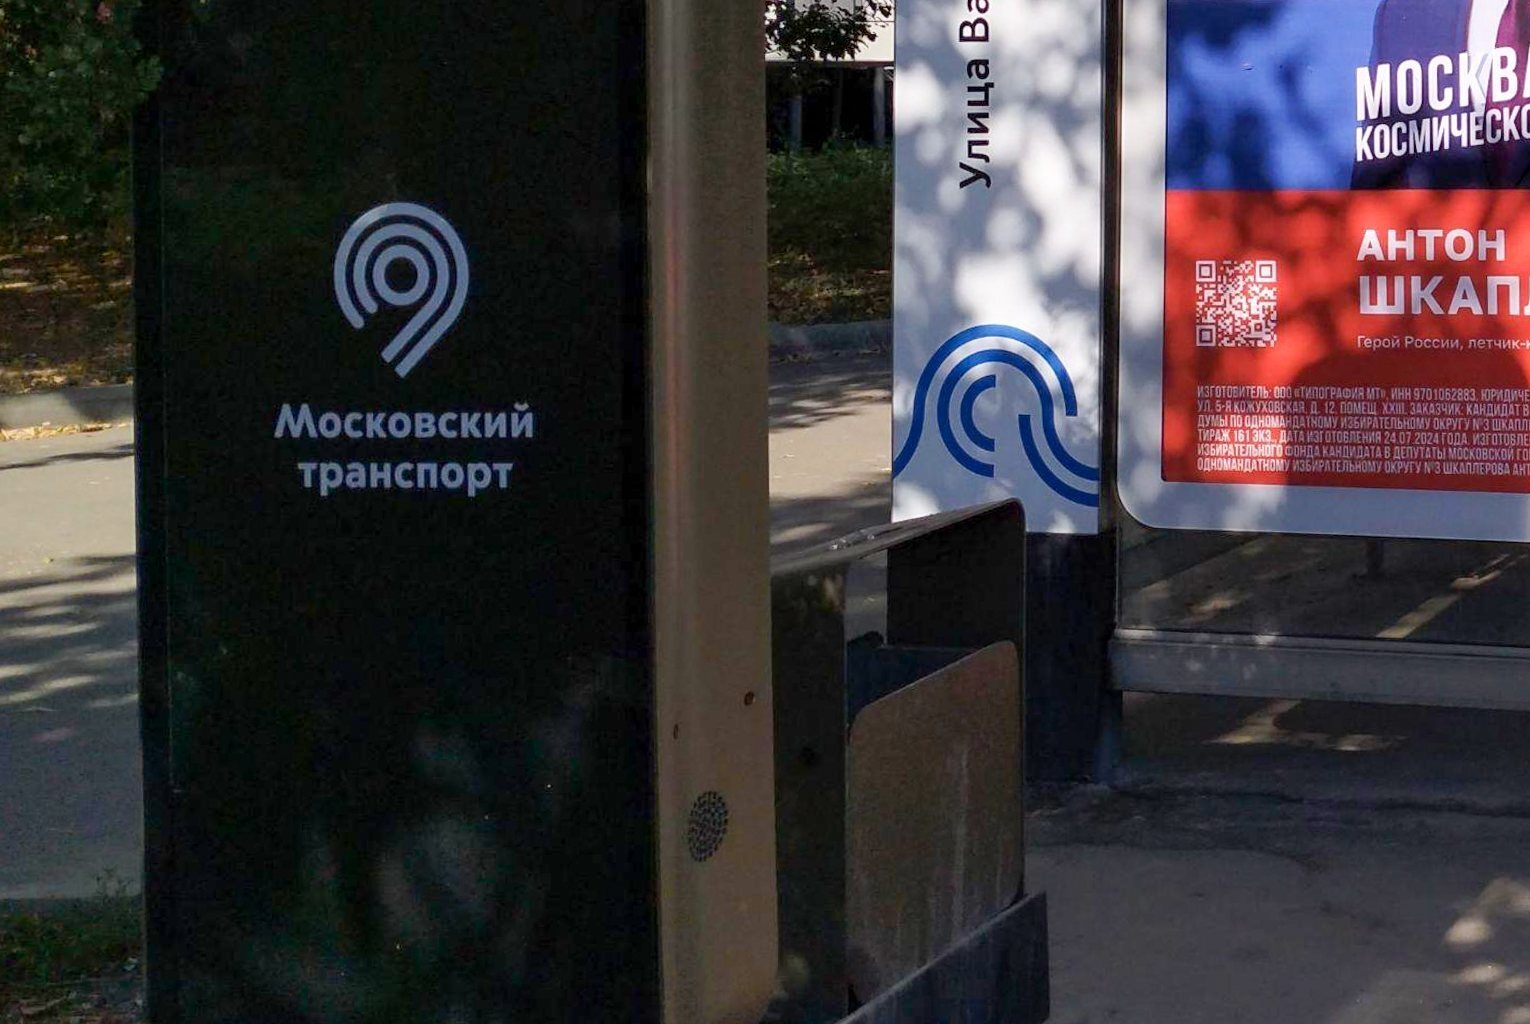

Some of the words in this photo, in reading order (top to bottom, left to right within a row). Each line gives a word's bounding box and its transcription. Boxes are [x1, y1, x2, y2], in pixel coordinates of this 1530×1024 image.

[958, 56, 995, 190] Улица
[1356, 228, 1506, 263] АНТОН
[1357, 335, 1400, 352] Герой
[1404, 336, 1464, 352] России,
[1197, 385, 1271, 398] ИЗГОТОВИТЕЛЬ:
[1273, 385, 1292, 398] ООО
[1294, 386, 1365, 400] «ТИПОГРАФИЯ
[1391, 387, 1411, 400] ИНН
[1215, 399, 1231, 413] 5-Я
[1410, 402, 1464, 416] ЗАКАЗЧИК:
[1466, 403, 1521, 417] КАНДИДАТ
[1523, 404, 1530, 417] В
[273, 401, 535, 439] Московский
[1197, 414, 1229, 428] ДУМЫ
[1231, 415, 1242, 427] ПО
[1244, 415, 1338, 429] ОДНОМАНДАТНОМУ
[1341, 416, 1431, 430] ИЗБИРАТЕЛЬНОМУ
[1434, 417, 1470, 431] ОКРУГУ
[1198, 428, 1231, 443] ТИРАЖ
[1234, 429, 1249, 442] 161
[1280, 430, 1305, 444] ДАТА
[1307, 431, 1382, 444] ИЗГОТОВЛЕНИЯ
[1384, 431, 1439, 445] 24.07.2024
[1197, 443, 1283, 457] ИЗБИРАТЕЛЬНОГО
[1285, 444, 1320, 458] ФОНДА
[1322, 445, 1382, 459] КАНДИДАТА
[1384, 446, 1391, 458] В
[1393, 446, 1446, 461] ДЕПУТАТЫ
[1448, 446, 1514, 461] МОСКОВСКОЙ
[1197, 457, 1290, 472] ОДНОМАНДАТНОМУ
[1292, 459, 1381, 473] ИЗБИРАТЕЛЬНОМУ
[1384, 460, 1421, 474] ОКРУГУ
[1443, 461, 1510, 476] ШКАПЛЕРОВА
[297, 461, 514, 497] транспорт
